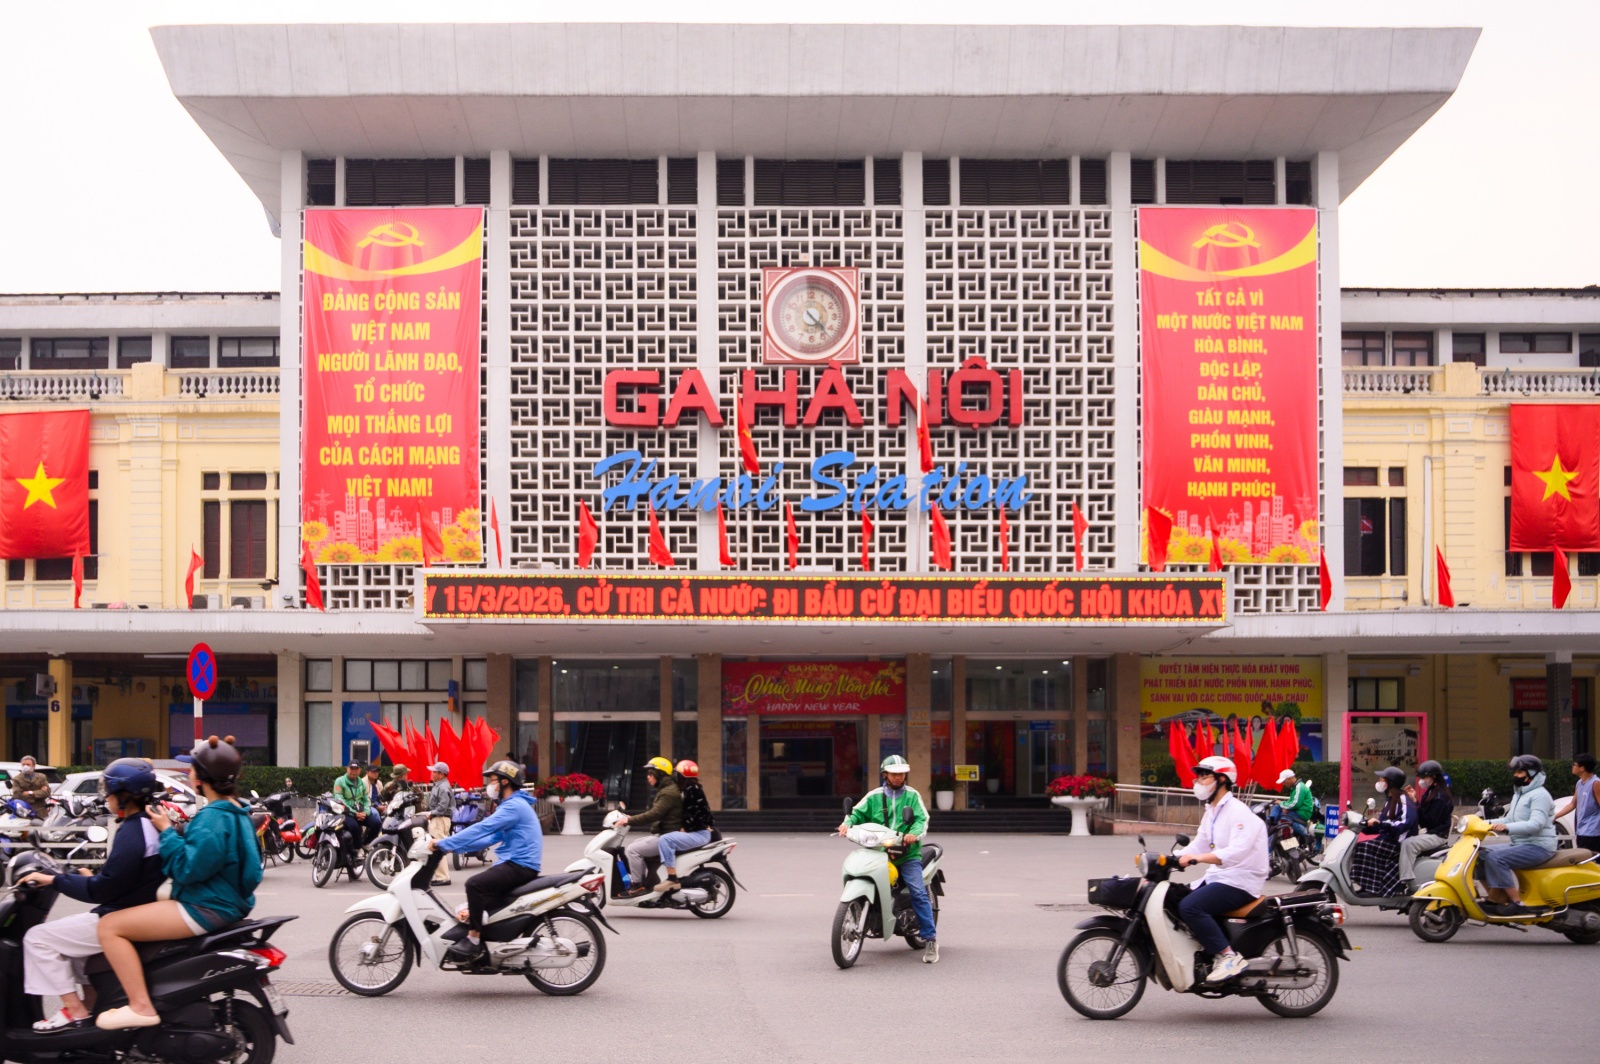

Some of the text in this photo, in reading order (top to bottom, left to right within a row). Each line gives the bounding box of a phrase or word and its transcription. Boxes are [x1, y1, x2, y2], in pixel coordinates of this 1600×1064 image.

[322, 287, 460, 314] ĐẢNG CỘNG SẢN
[1196, 287, 1263, 306] TẤT CẢ VÌ
[351, 319, 430, 344] VIỆT NAM
[1156, 312, 1303, 332] MỘT NƯỚC VIỆT NAM
[1194, 336, 1267, 354] HÒA BÌNH,
[317, 349, 462, 374] NGƯỜI LÃNH ĐẠO,
[1199, 359, 1262, 379] ĐỘC LẬP,
[353, 377, 424, 402] TỔ CHỨC
[604, 356, 1022, 430] GA HÀ NỘI
[1197, 381, 1266, 401] DÂN CHỦ,
[326, 408, 452, 438] MỌI THẮNG LỢI
[1188, 407, 1275, 427] GIÀU MẠNH,
[1190, 429, 1273, 450] PHỒN VINH,
[319, 440, 460, 469] CỦA CÁCH MẠNG
[1193, 454, 1270, 474] VĂN MINH,
[345, 473, 432, 501] VIỆT NAM!
[594, 449, 1034, 512] Hanoi Station
[1186, 479, 1276, 499] HẠNH PHÚC!
[444, 585, 570, 616] 15/3/2026,
[578, 578, 612, 612] CỬ
[616, 586, 654, 612] TRI
[660, 578, 694, 614] CẢ
[772, 588, 798, 615] ĐI
[860, 580, 896, 615] CỬ
[900, 588, 940, 619] ĐẠI
[947, 580, 1002, 615] BIỂU
[1010, 580, 1074, 618] QUỐC
[1080, 584, 1121, 620] HỘI
[1128, 584, 1194, 615] KHÓA
[805, 664, 818, 672] HÀ
[820, 664, 838, 672] NỘI
[50, 700, 60, 712] 6
[766, 702, 800, 711] HAPPY
[1560, 698, 1570, 710] 7
[349, 717, 366, 725] VIB
